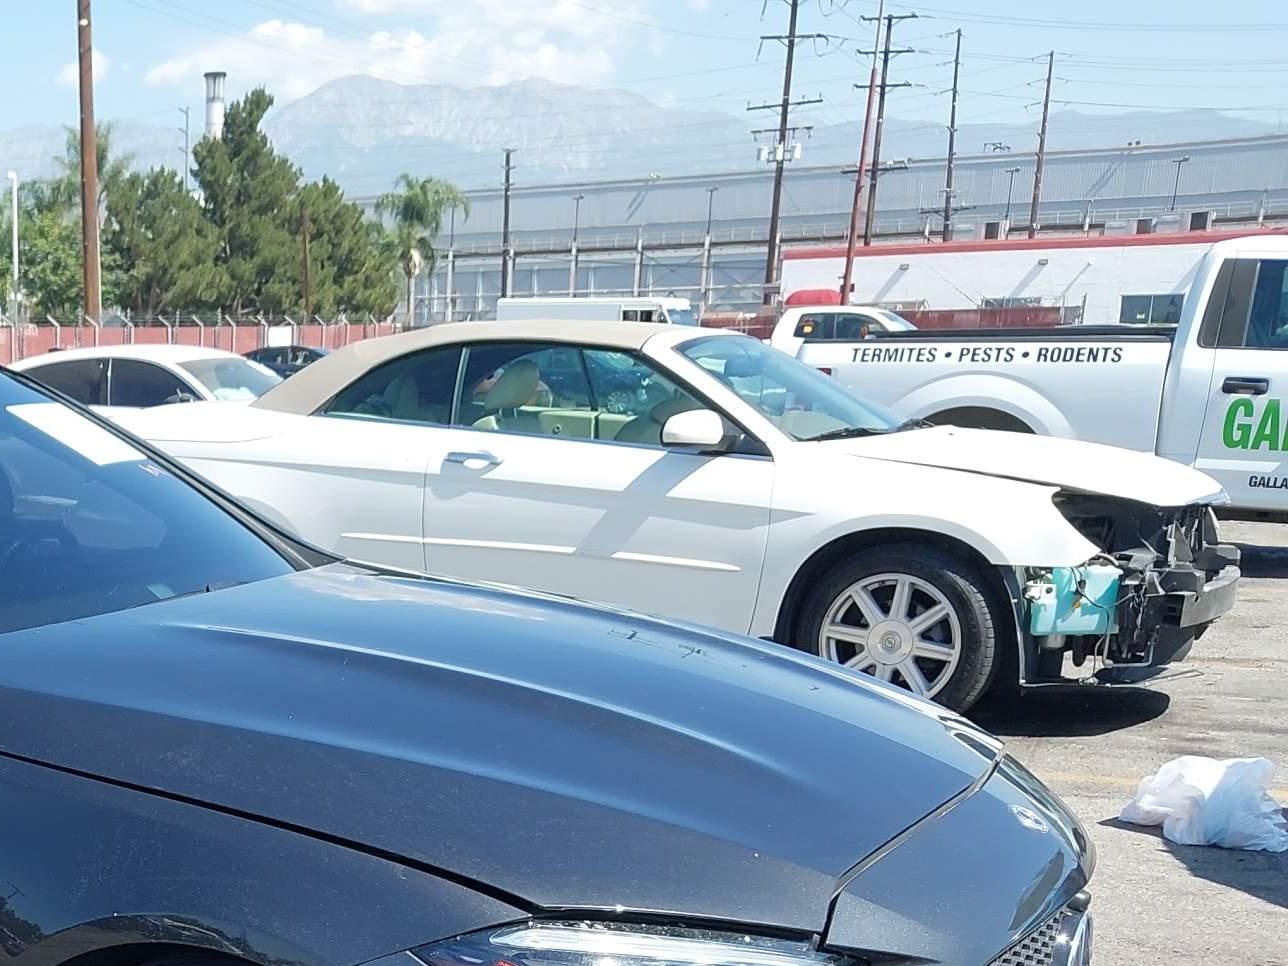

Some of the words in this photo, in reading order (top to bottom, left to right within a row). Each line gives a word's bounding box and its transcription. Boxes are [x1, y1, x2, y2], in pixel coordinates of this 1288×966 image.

[851, 347, 938, 363] TERMITES
[958, 347, 1016, 363] PESTS
[1036, 347, 1124, 363] RODENTS
[1222, 397, 1288, 451] GA
